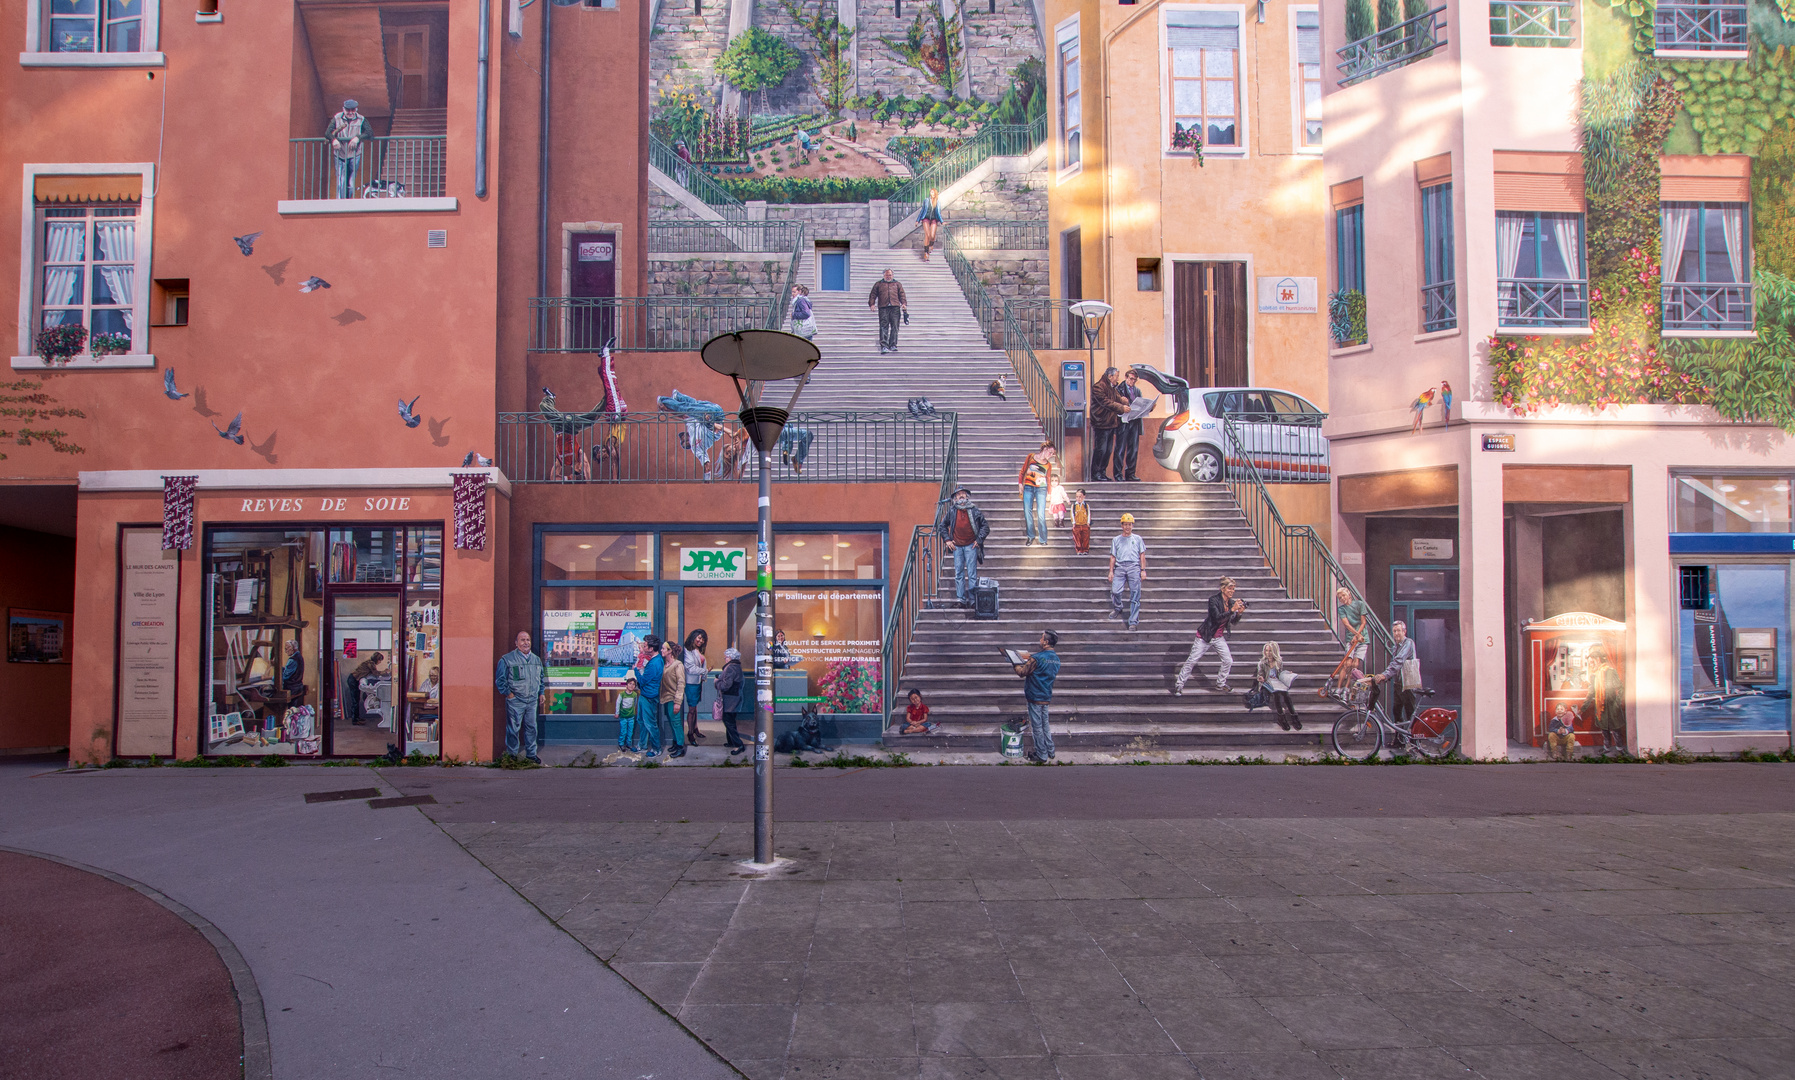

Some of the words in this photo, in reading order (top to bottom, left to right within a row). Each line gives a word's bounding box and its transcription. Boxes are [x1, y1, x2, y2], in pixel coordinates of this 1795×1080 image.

[241, 499, 303, 512] REVES
[320, 498, 347, 511] DE
[364, 497, 410, 511] SOIE
[830, 592, 881, 600] département
[1487, 636, 1493, 647] 3
